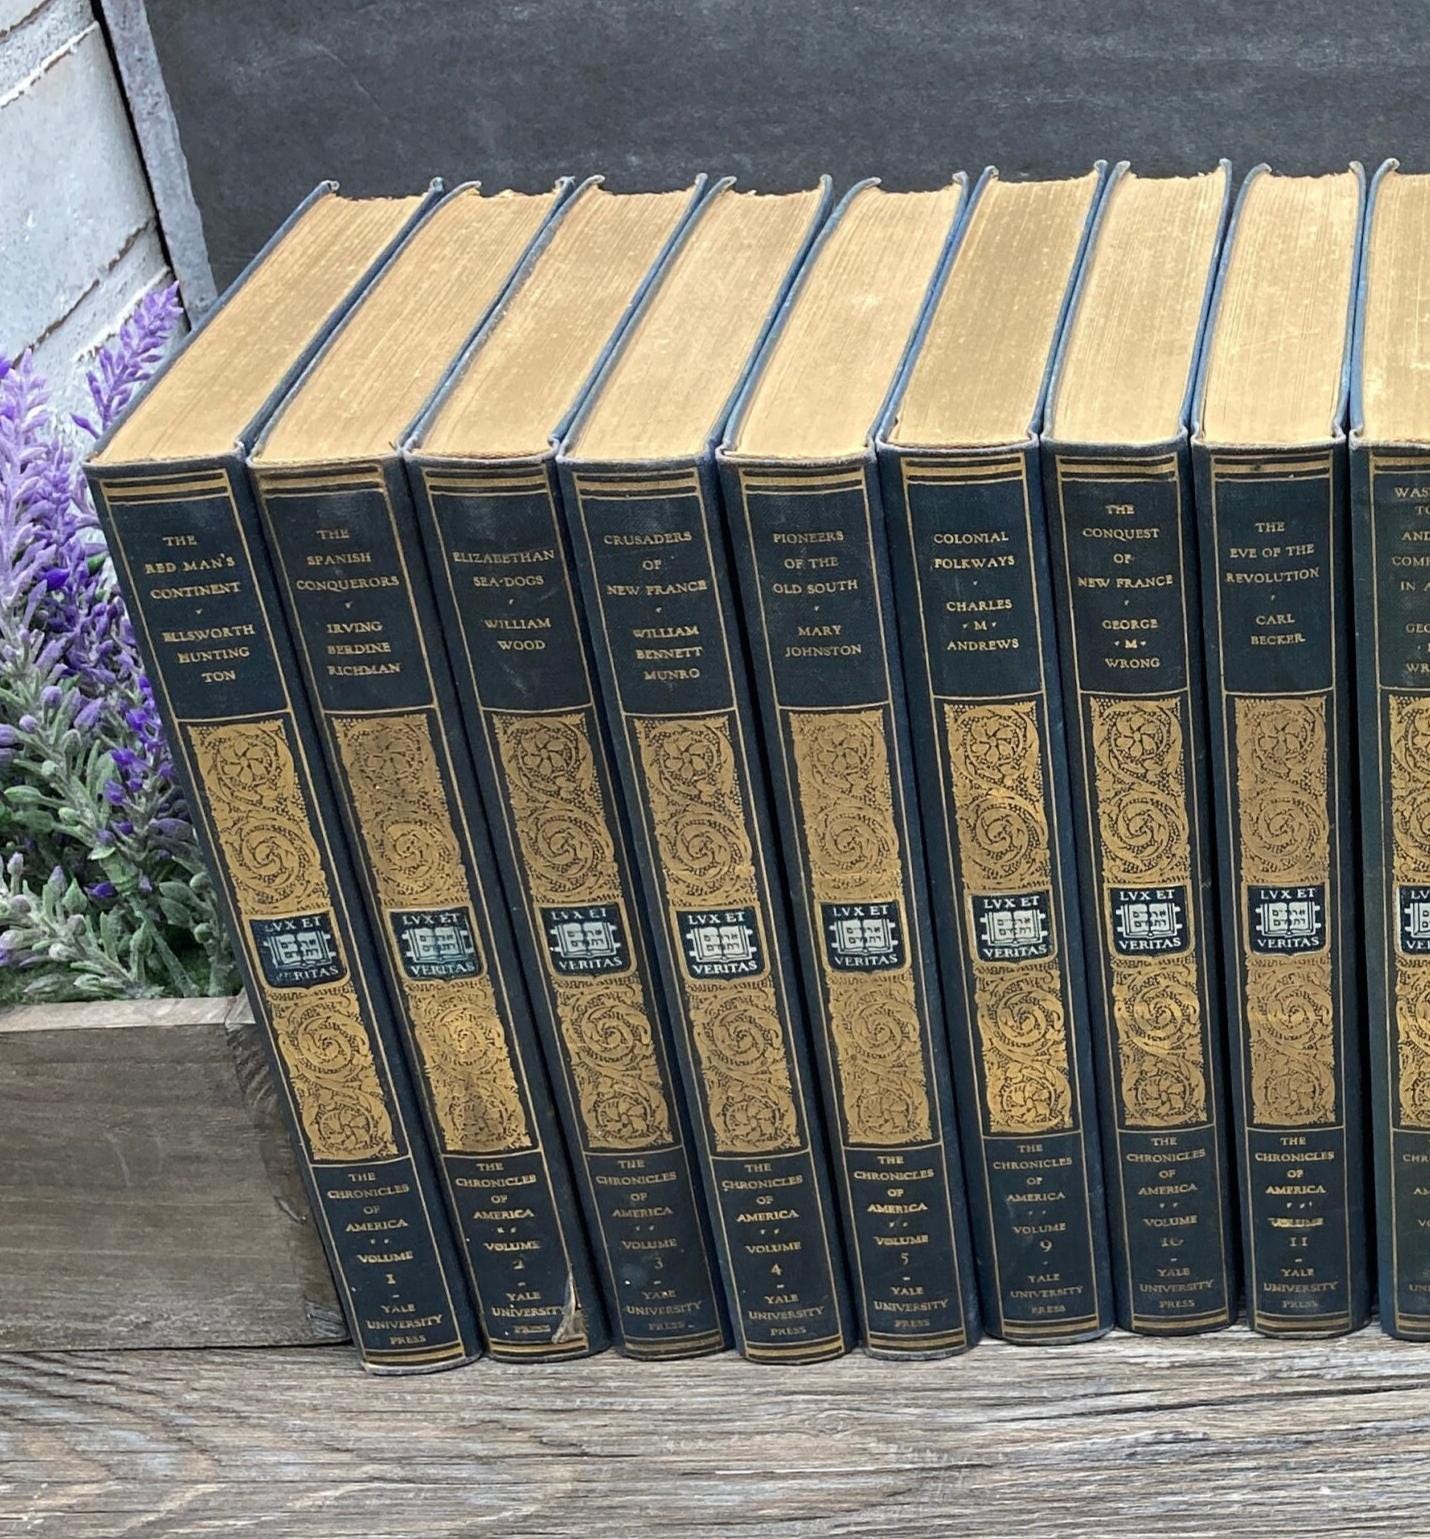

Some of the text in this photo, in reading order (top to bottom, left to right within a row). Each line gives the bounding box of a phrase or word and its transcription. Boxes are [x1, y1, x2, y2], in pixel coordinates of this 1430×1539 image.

[1104, 504, 1135, 515] THE
[1081, 527, 1161, 542] CONQUEST
[1254, 521, 1286, 534] THE
[161, 535, 198, 547] THE
[603, 530, 693, 546] CRUSADERS
[772, 530, 845, 545] PIONEERS
[933, 530, 1010, 545] COLONIAL
[452, 549, 555, 564] ELIZABETHAN
[1229, 543, 1315, 559] EVE OF THE
[143, 552, 236, 575] RED MAN'S
[306, 551, 372, 566] SPANISH
[641, 559, 662, 571] OF
[783, 556, 839, 570] OF THE
[933, 554, 1015, 572] FOLKWAYS
[1112, 553, 1134, 565] OF
[1077, 574, 1174, 589] NEW FRANCE
[1224, 566, 1320, 584] REVOLUTION
[149, 581, 241, 600] CONTINENT
[295, 575, 400, 593] CONQUERORS
[606, 579, 708, 596] NEW FRANCE
[771, 578, 859, 595] OLD SOUTH
[1400, 581, 1416, 592] IN
[945, 598, 1013, 613] CHARLES
[483, 617, 552, 630] WILLIAM
[1101, 618, 1159, 631] GEORGE
[1255, 613, 1296, 626] CARL
[161, 623, 256, 643] ELLSWORTH
[326, 620, 384, 634] IRVING
[632, 625, 700, 639] WILLIAM
[797, 624, 842, 637] MARY
[496, 639, 546, 651] WOOD
[946, 637, 1020, 652] ANDREWS
[1250, 632, 1307, 646] BECKER
[176, 646, 251, 664] HUNTING
[326, 641, 392, 655] BERDINE
[635, 645, 704, 661] BENNETT
[784, 643, 862, 658] JOHNSTON
[326, 662, 401, 677] RICHMAN
[1104, 657, 1161, 670] WRONG
[200, 669, 237, 683] TON
[643, 667, 701, 681] MUNRO
[1295, 889, 1316, 900] ET
[719, 911, 743, 924] ET
[1257, 936, 1319, 949] VERITAS
[690, 959, 757, 974] VERITAS
[1150, 1136, 1178, 1147] THE
[992, 1156, 1073, 1170] CHRONICLES
[853, 1168, 935, 1182] CHRONICLES
[735, 1208, 800, 1223] AMERICA
[866, 1202, 929, 1215] AMERICA
[345, 1218, 409, 1233] AMERICA
[355, 1250, 414, 1264] VOLUME
